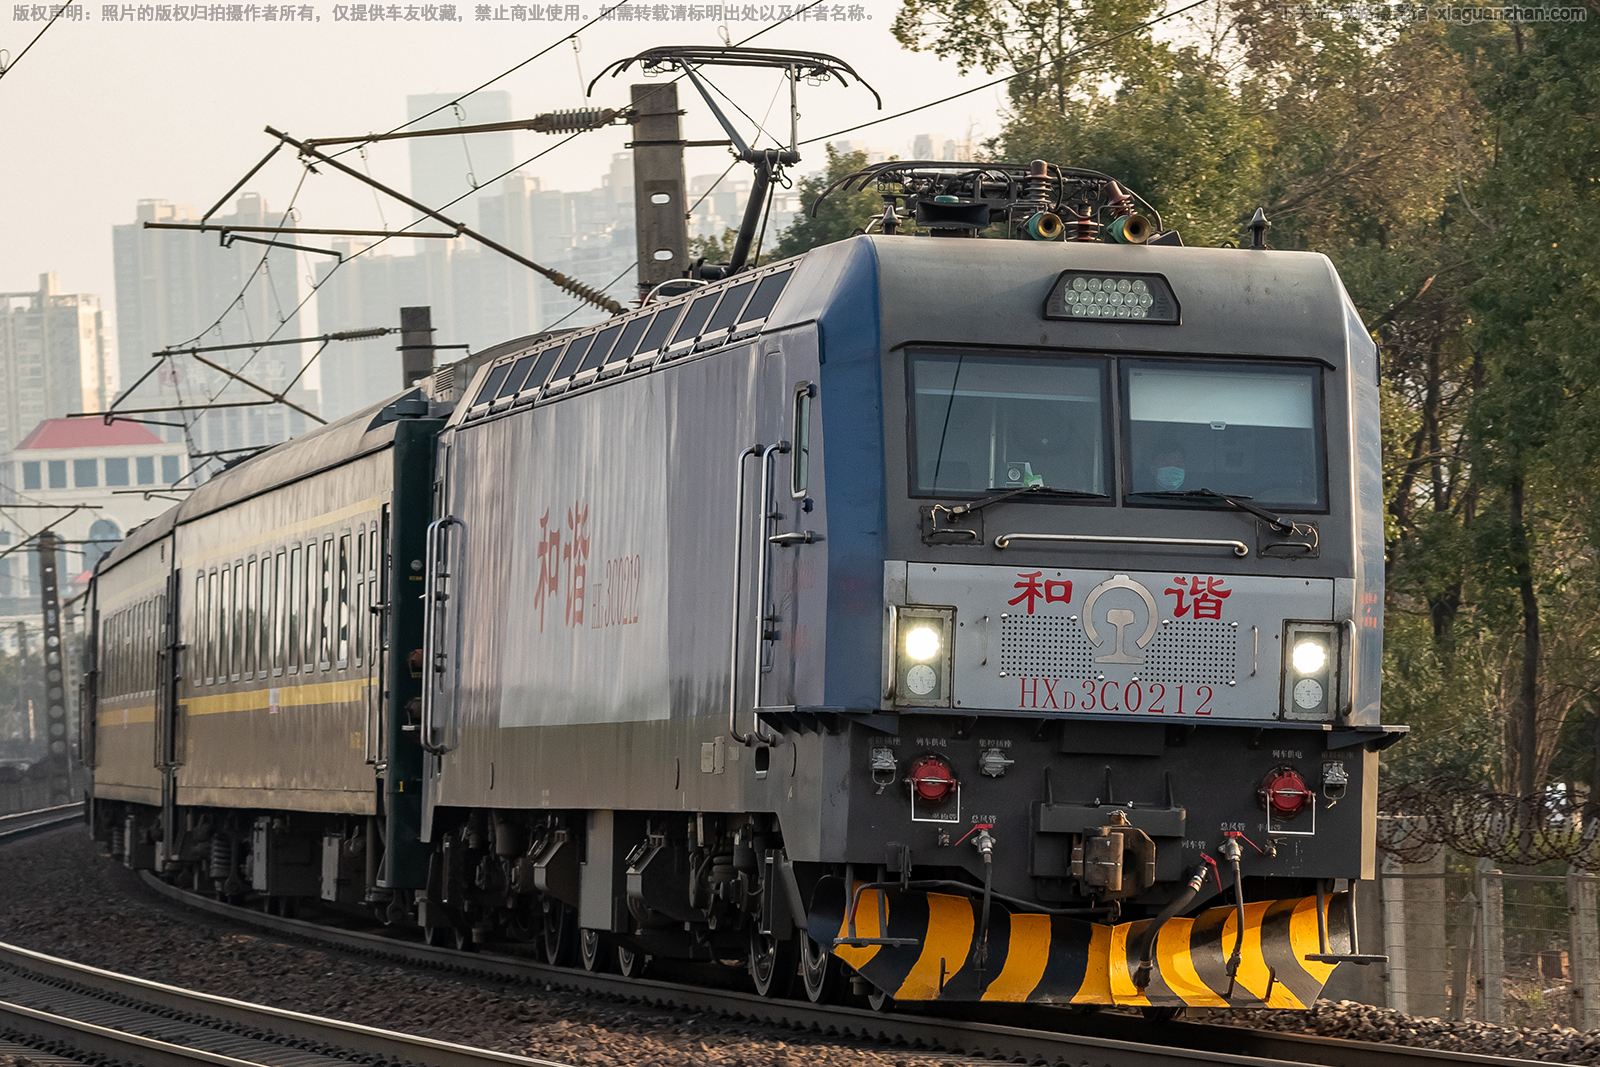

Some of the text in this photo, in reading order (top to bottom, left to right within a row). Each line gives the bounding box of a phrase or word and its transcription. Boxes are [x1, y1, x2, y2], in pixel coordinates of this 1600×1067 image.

[534, 498, 591, 634] 和谐
[1007, 571, 1232, 620] 和 谐
[1018, 677, 1213, 716] HXD3C0212
